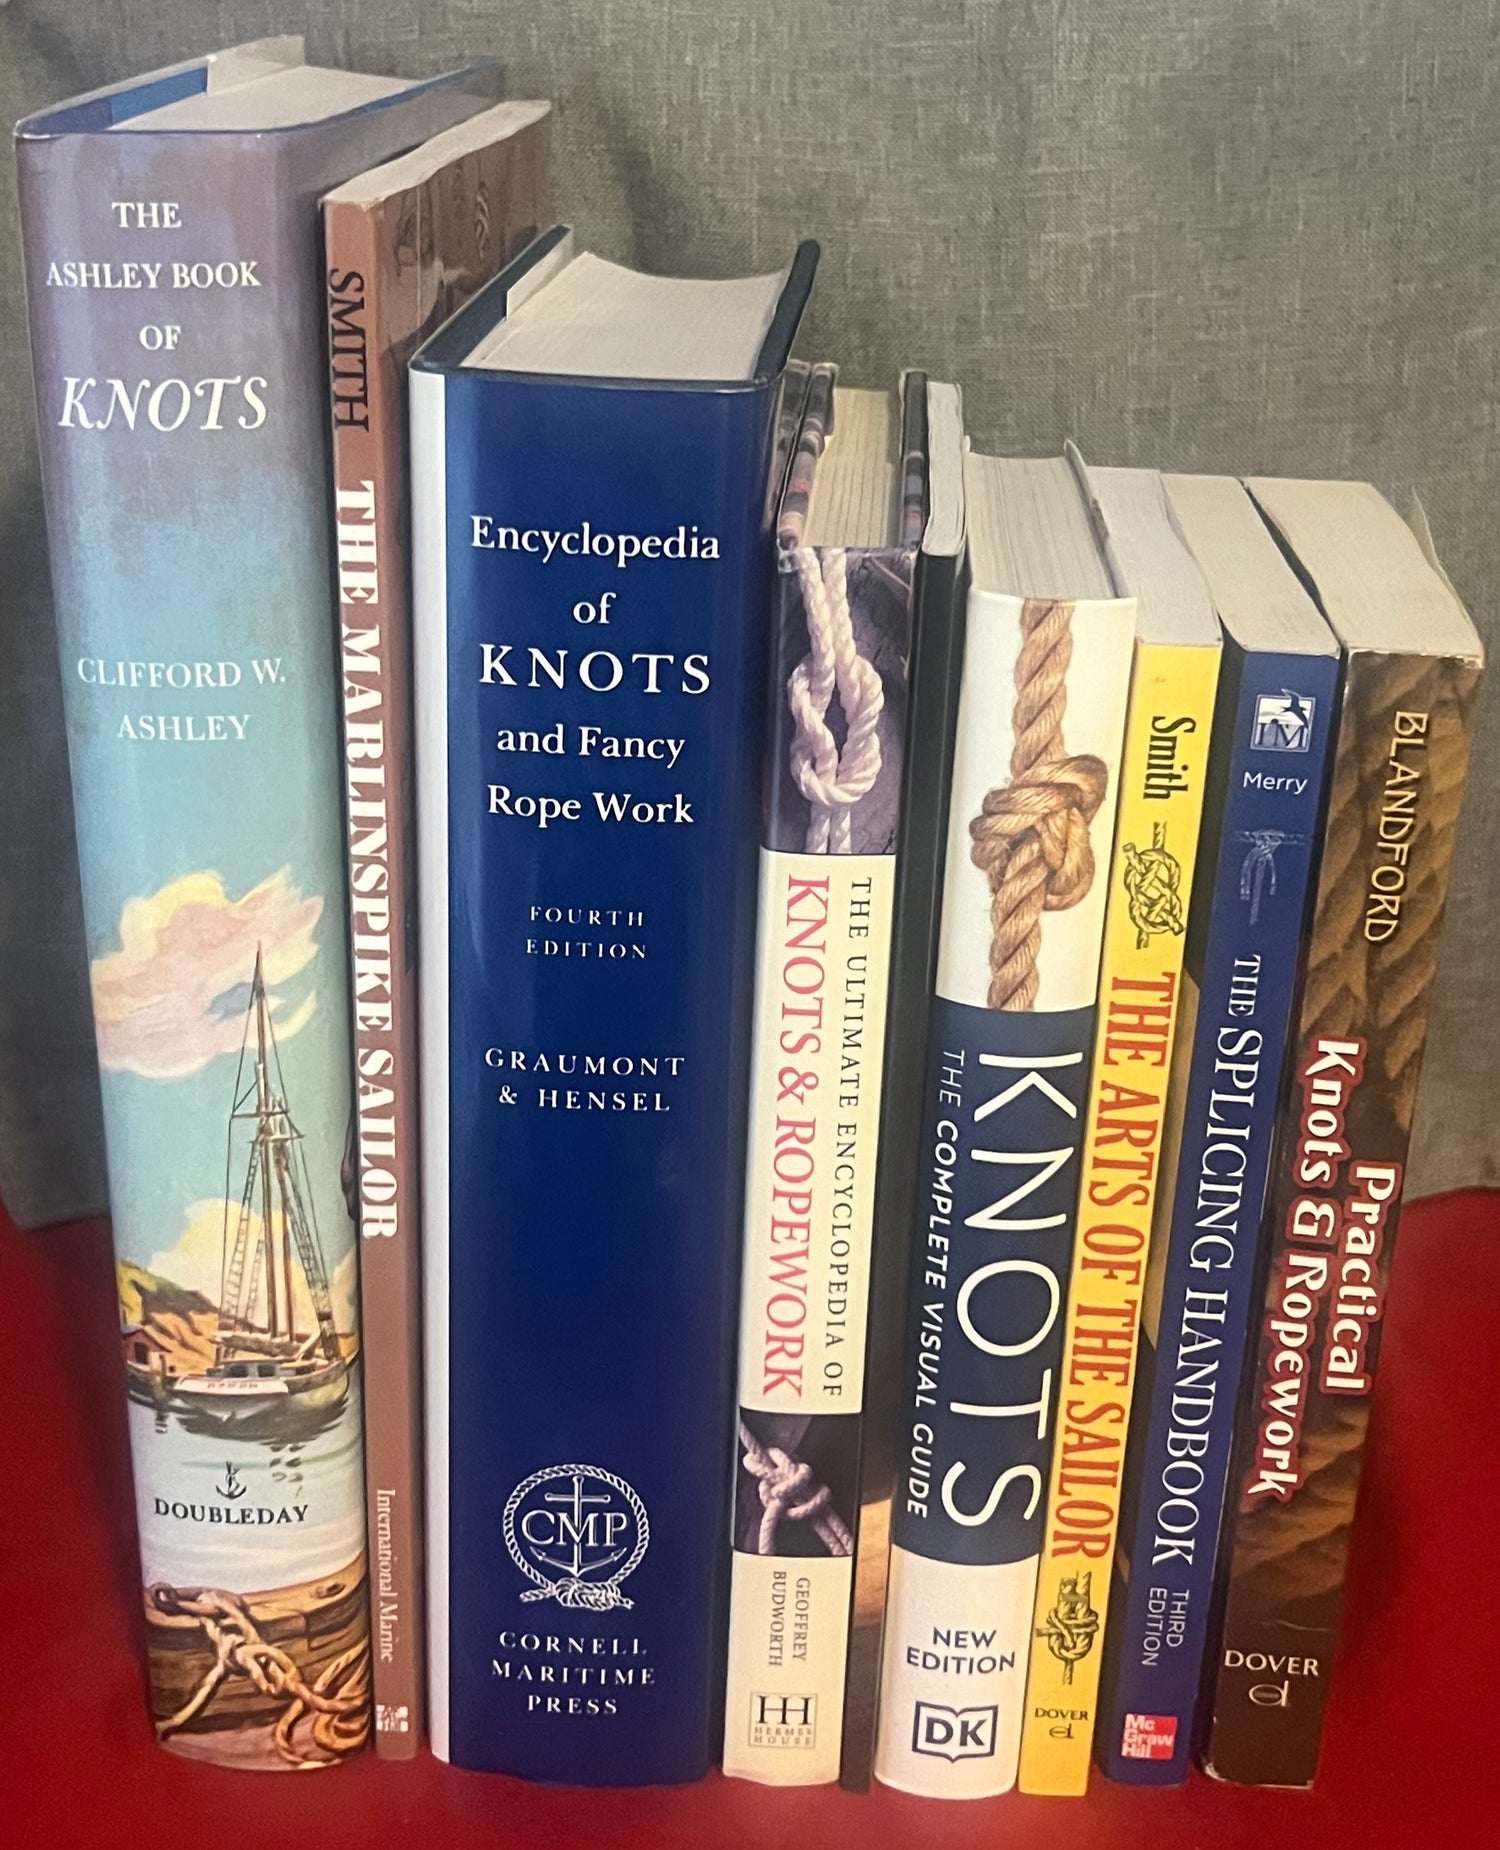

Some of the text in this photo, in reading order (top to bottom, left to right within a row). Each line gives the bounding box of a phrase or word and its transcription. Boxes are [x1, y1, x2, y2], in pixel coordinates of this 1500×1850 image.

[111, 202, 182, 229] THE
[46, 261, 262, 289] ASHLEY BOOK
[139, 325, 182, 351] OF
[328, 267, 369, 433] SMITH
[58, 376, 269, 432] KNOTS
[470, 515, 721, 567] Encyclopedia
[572, 592, 617, 624] of
[77, 657, 287, 688] CLIFFORD W.
[479, 644, 711, 694] KNOTS
[117, 714, 251, 741] ASHLEY
[496, 723, 686, 769] and Fancy
[1142, 715, 1197, 800] Smith
[1242, 771, 1309, 795] Merry
[486, 784, 695, 828] Rope Work
[1363, 710, 1429, 942] BLANDFORD
[336, 480, 398, 1239] THE MARLINSPIKE SAILOR
[529, 905, 645, 928] FOURTH
[525, 938, 647, 960] EDITION
[484, 1047, 685, 1076] GRAUMONT
[499, 1084, 671, 1112] & HENSEL
[762, 874, 830, 1398] KNOTS & ROPEWORK
[822, 876, 873, 1396] THE ULTIMATE ENCYCLOPEDIA OF
[1051, 971, 1177, 1560] THE ARTS OF THE SAILOR
[1151, 953, 1264, 1566] THE SPLICING HANDBOOK
[1247, 1039, 1361, 1496] Knots & Ropework
[906, 1049, 965, 1519] THE COMPLETE VISUAL GUIDE
[941, 1051, 1083, 1527] KNOTS
[1325, 1166, 1396, 1390] Practical
[153, 1497, 310, 1526] DOUBLEDAY
[521, 1509, 629, 1547] CMP
[376, 1488, 399, 1598] International
[768, 1570, 787, 1667] BUDWORTH
[792, 1576, 812, 1663] GEOFFREY
[1141, 1586, 1168, 1667] EDITION
[1166, 1589, 1190, 1648] THIRD
[499, 1630, 649, 1656] CORNELL
[932, 1626, 998, 1649] NEW
[491, 1659, 656, 1685] MARITIME
[906, 1646, 1016, 1675] EDITION
[1224, 1649, 1320, 1677] DOVER
[527, 1694, 619, 1715] PRESS
[1034, 1707, 1089, 1721] DOVER
[1125, 1713, 1156, 1731] Mc
[924, 1716, 988, 1747] DK
[1123, 1729, 1174, 1746] Graw
[1121, 1742, 1152, 1758] Hill
